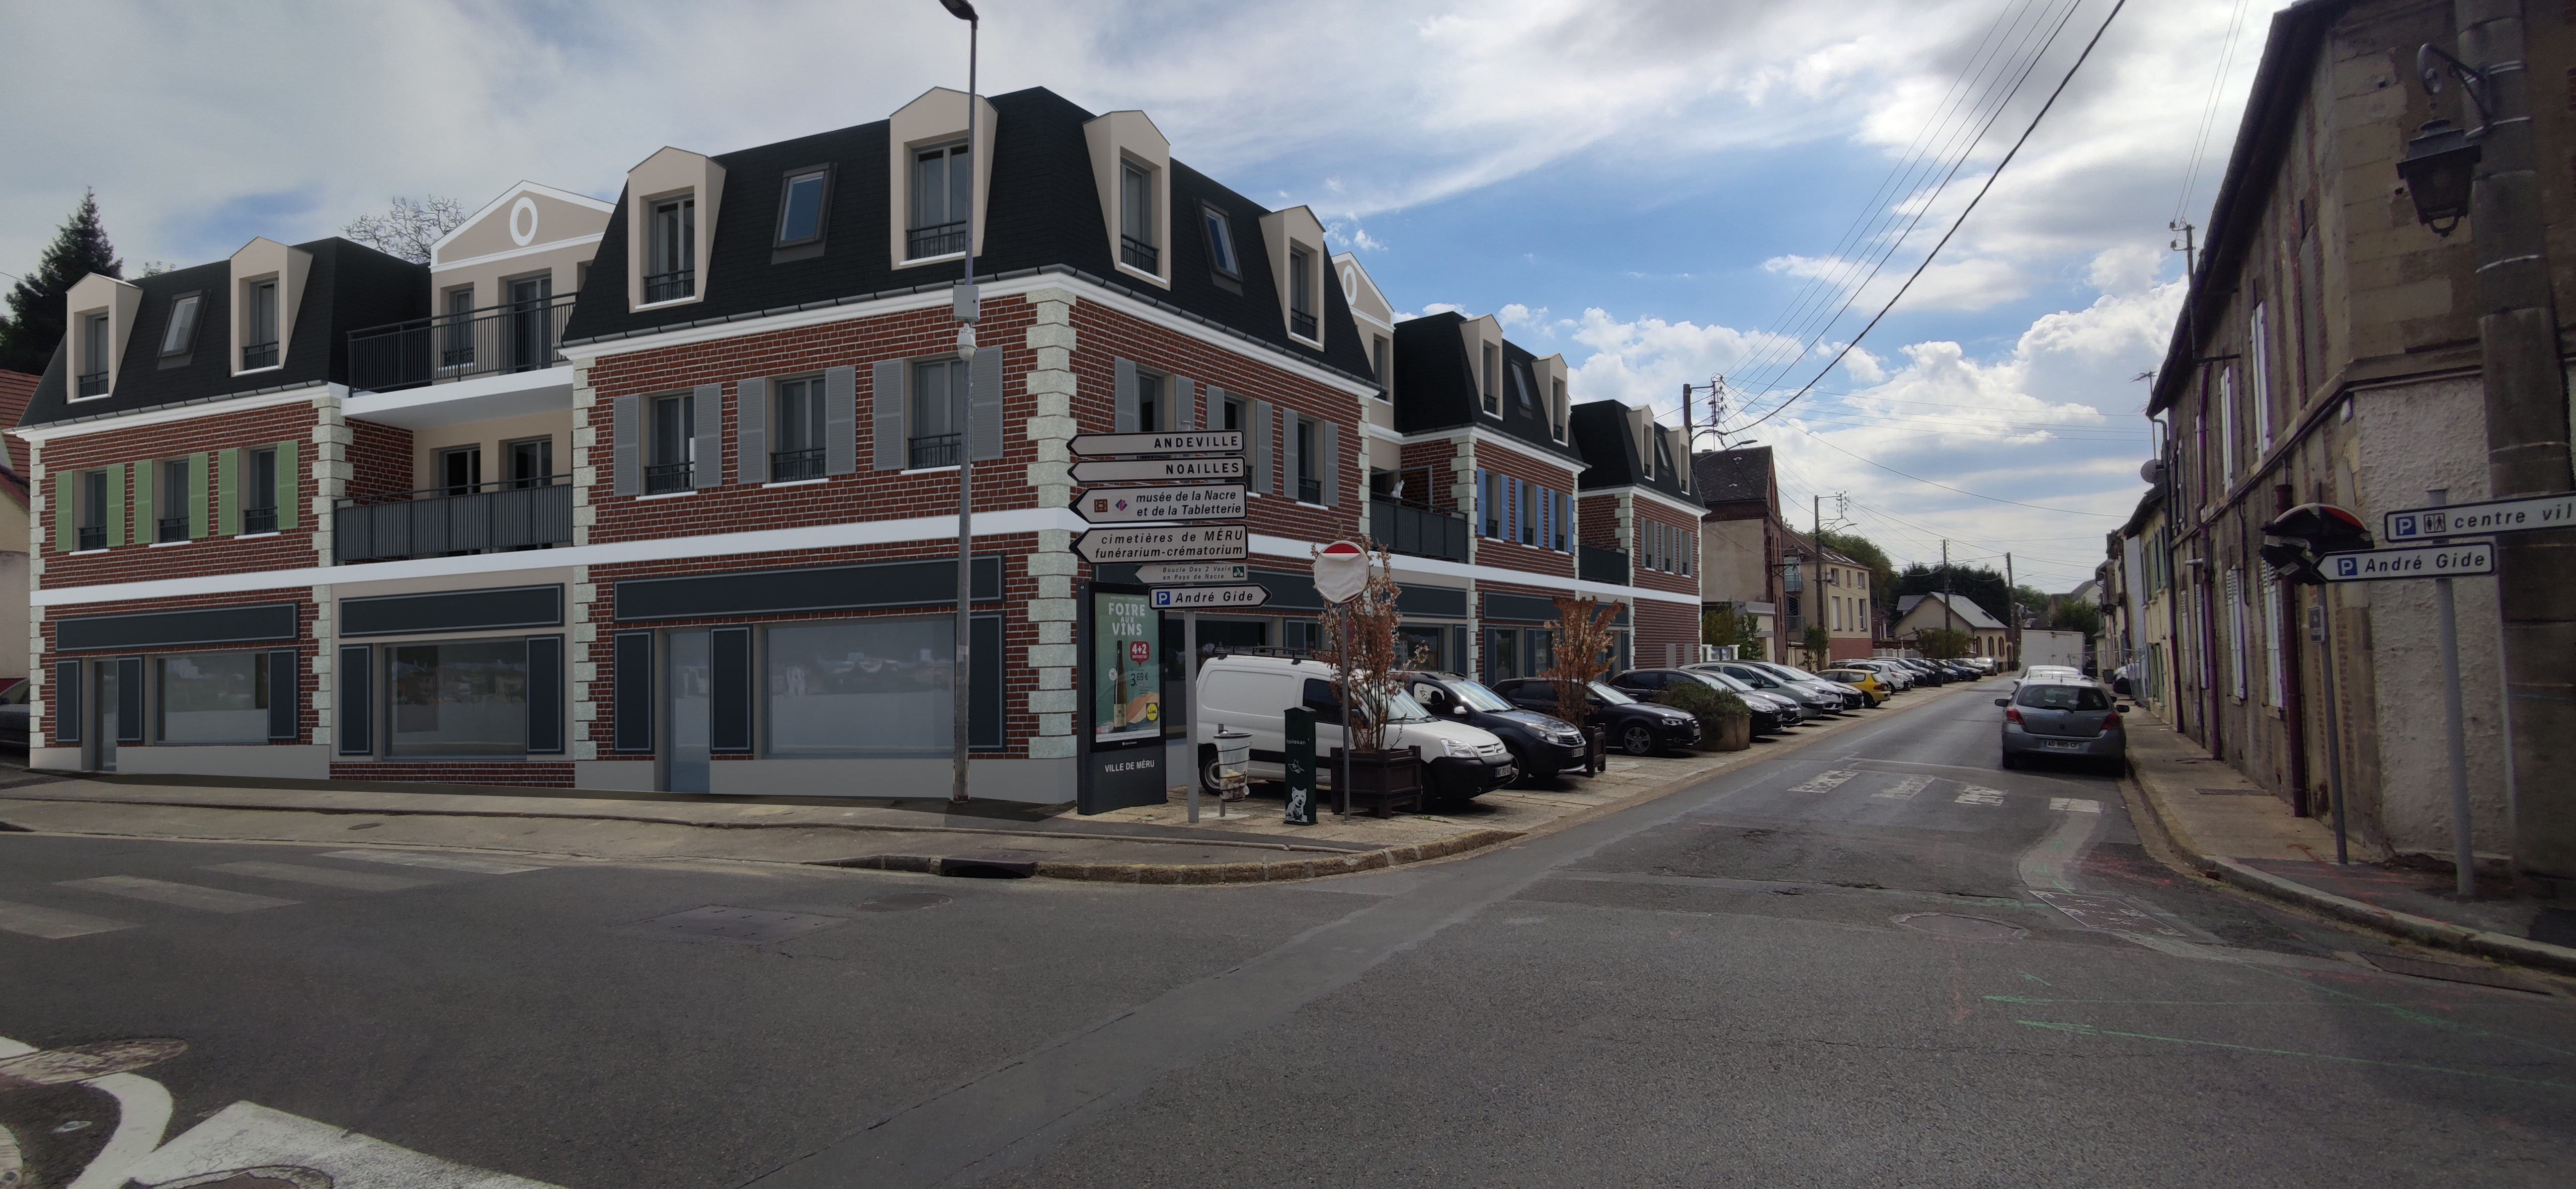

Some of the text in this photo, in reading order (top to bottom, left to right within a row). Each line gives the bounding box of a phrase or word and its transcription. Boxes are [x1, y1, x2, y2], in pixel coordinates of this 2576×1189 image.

[1154, 436, 1238, 448] ANDEVILLE
[1166, 462, 1239, 475] NOAILLES
[1136, 490, 1236, 503] musée de la Nacre
[1137, 503, 1241, 516] et de la Tabletterie
[2454, 511, 2526, 529] centre
[1101, 528, 1243, 544] cimetières de MÉRU
[1095, 544, 1242, 559] funérarium-crématorium
[2365, 555, 2422, 573] André
[2436, 552, 2485, 569] Gide
[1175, 592, 1214, 603] André
[1223, 591, 1253, 602] Gide
[1109, 602, 1145, 616] FOIRE
[1112, 622, 1142, 635] VINS
[1131, 643, 1147, 654] 4+2
[1105, 759, 1155, 772] VILLE DE MÉRU
